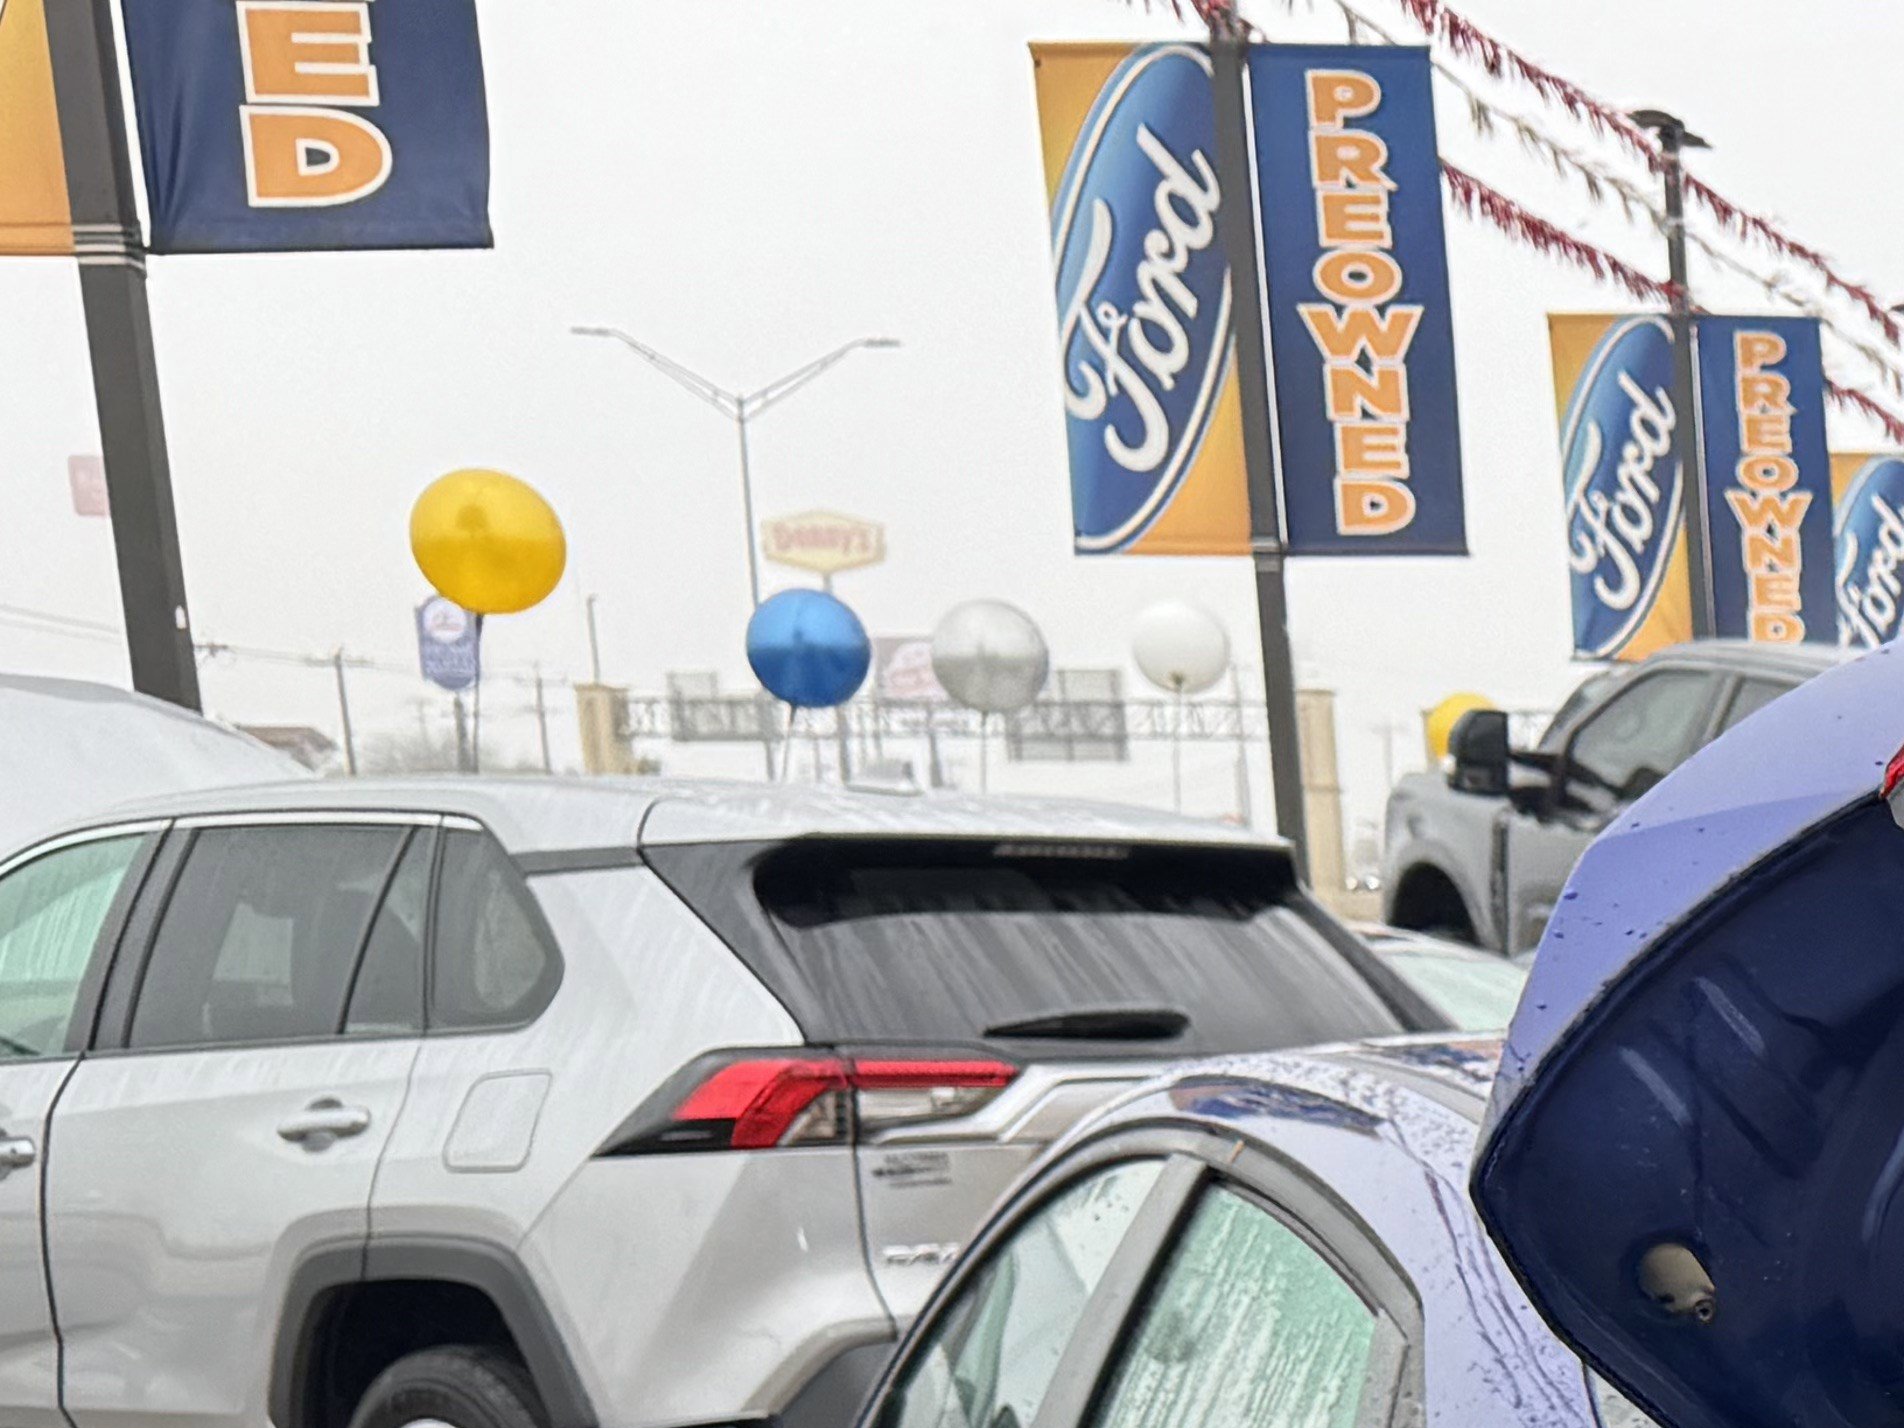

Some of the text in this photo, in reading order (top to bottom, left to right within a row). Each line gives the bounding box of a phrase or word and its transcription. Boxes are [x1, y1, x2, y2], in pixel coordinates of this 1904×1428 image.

[1062, 122, 1222, 472] Ford
[1297, 68, 1424, 536] PREOWNED
[1567, 371, 1677, 610] Ford
[1725, 329, 1813, 644] PREOWNED
